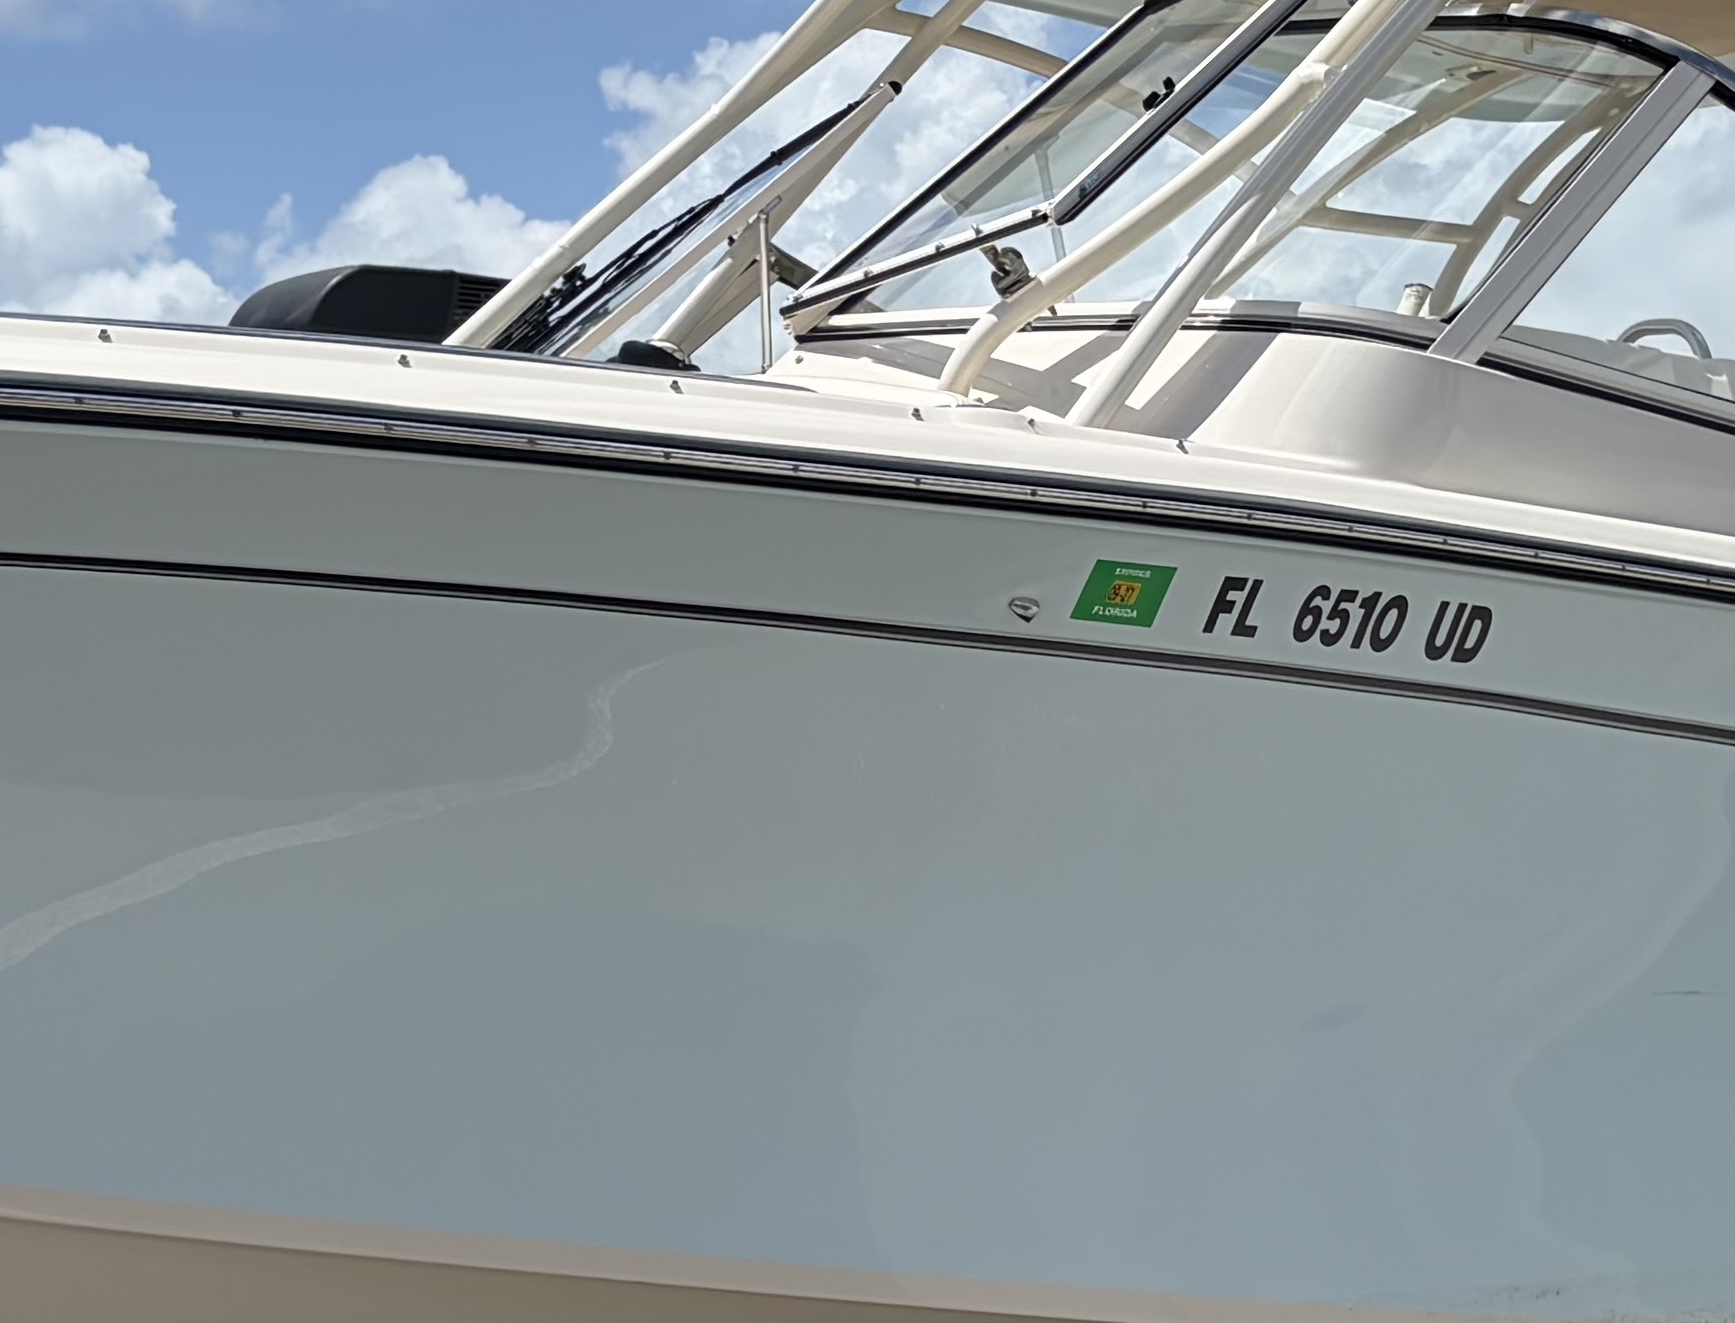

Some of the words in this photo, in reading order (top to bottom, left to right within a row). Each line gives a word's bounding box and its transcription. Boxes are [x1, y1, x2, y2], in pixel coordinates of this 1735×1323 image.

[1202, 576, 1264, 638] FL
[1292, 584, 1409, 653] 6510
[1424, 600, 1493, 664] UD
